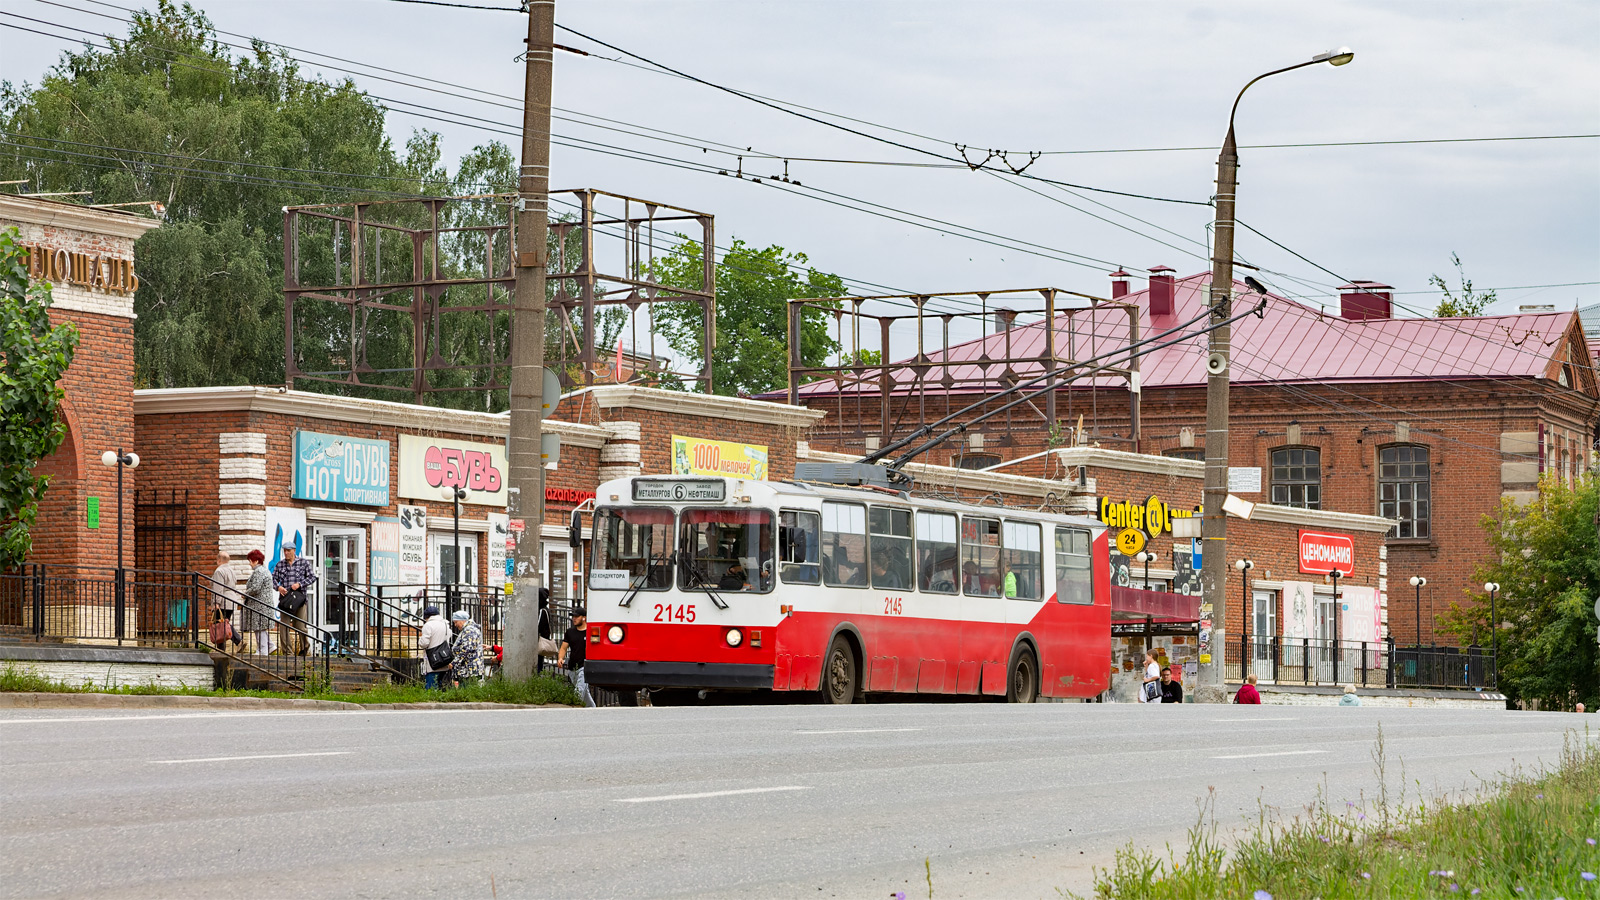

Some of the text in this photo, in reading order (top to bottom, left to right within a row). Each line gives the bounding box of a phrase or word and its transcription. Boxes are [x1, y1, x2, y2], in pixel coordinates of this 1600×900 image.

[344, 442, 388, 487] ОБУВЬ
[426, 461, 442, 470] ВАША
[693, 443, 751, 475] 1000 мелочей
[424, 445, 502, 493] ОБУВЬ
[343, 487, 387, 505] СПОРТИВНАЯ
[638, 489, 720, 499] МЕТАЛЛУРГОВ НЕФТЕМАШ
[674, 485, 683, 499] 6
[1101, 496, 1145, 530] Center
[1150, 509, 1159, 528] CL
[402, 534, 423, 542] КОЖАНАЯ
[402, 543, 423, 551] МУЖСКАЯ
[1124, 534, 1136, 544] 24
[402, 552, 422, 563] ОБУВЬ
[1302, 542, 1351, 564] ЦЕНОМАНИЯ
[372, 556, 398, 581] ОБУВЬ
[653, 603, 696, 623] 2145
[884, 596, 903, 615] 2145
